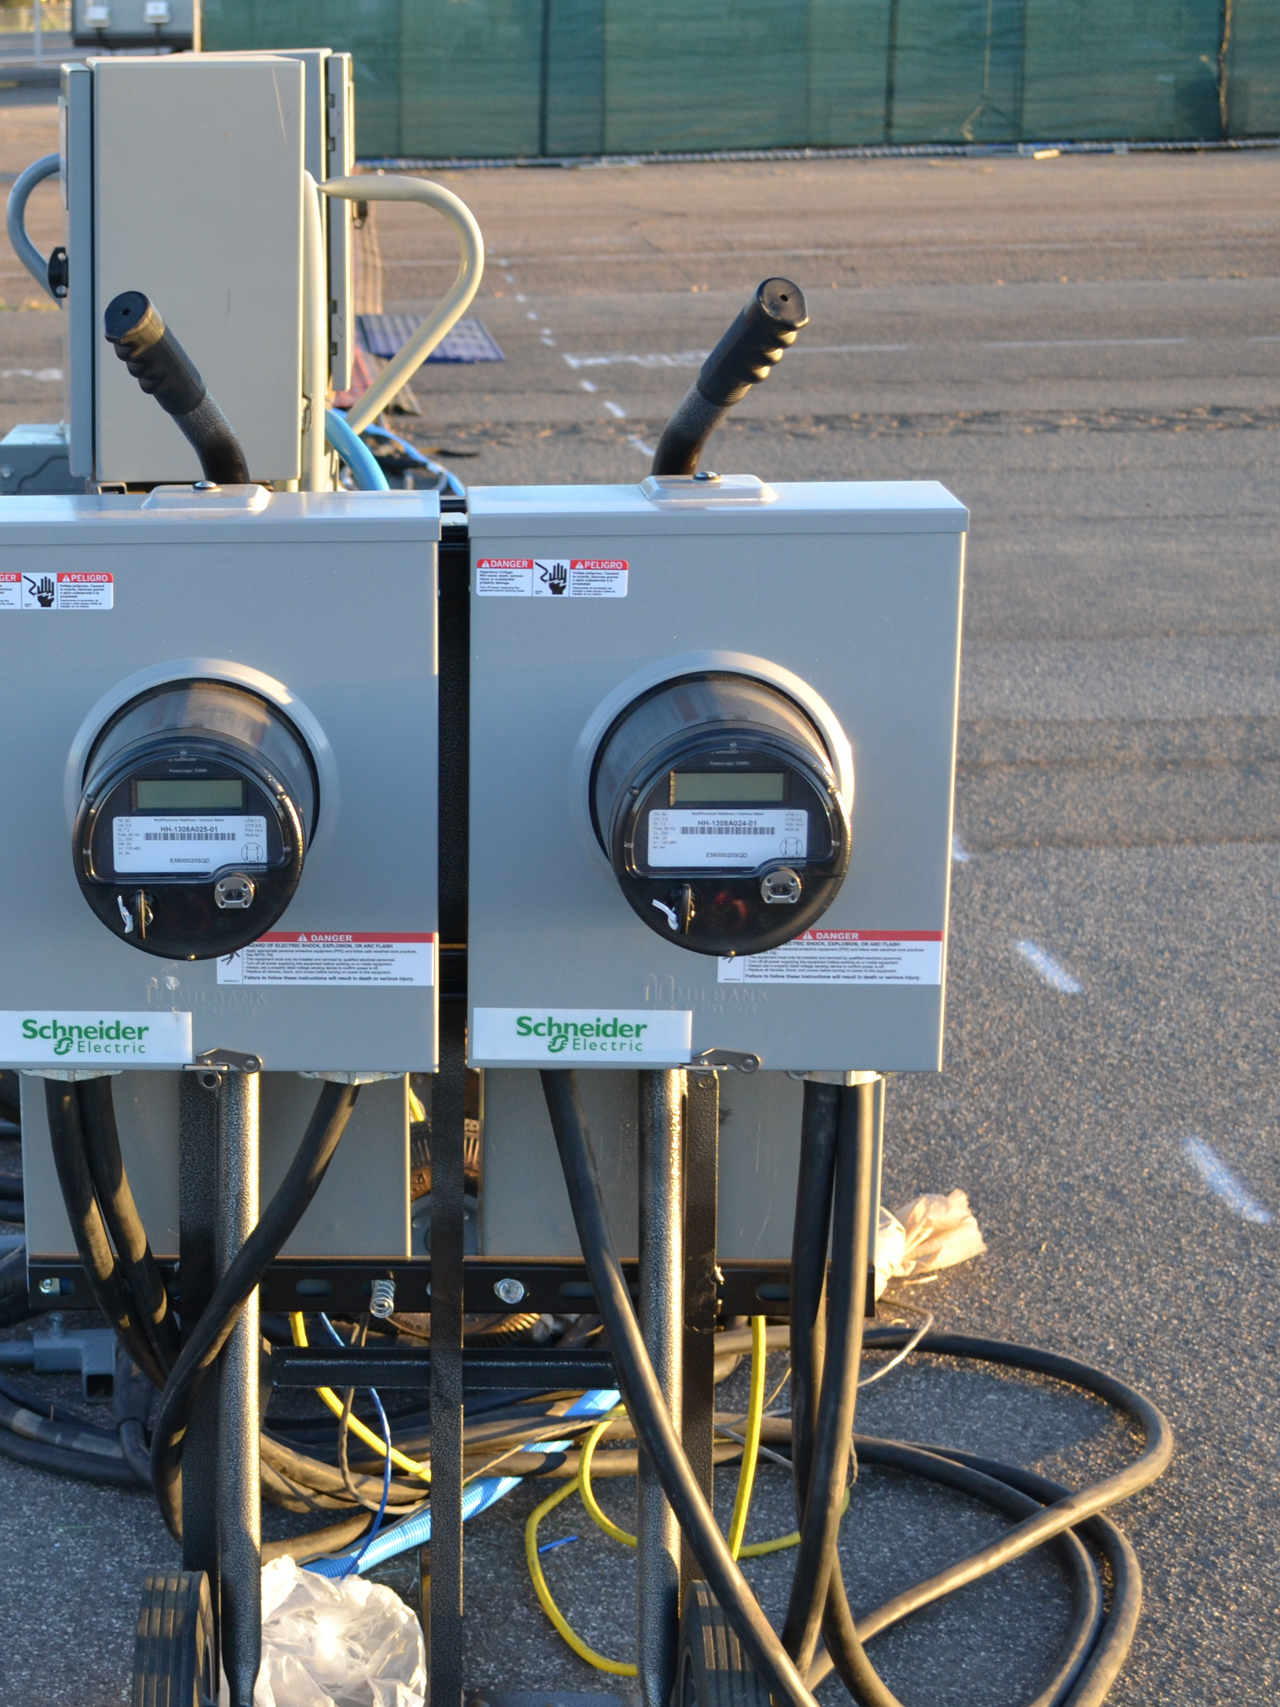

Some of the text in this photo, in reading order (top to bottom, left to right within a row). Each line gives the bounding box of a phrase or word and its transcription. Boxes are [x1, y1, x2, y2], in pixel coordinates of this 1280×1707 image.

[22, 1019, 149, 1040] Schneider
[516, 1016, 647, 1038] Schneider
[78, 1041, 146, 1053] Electric
[573, 1039, 643, 1051] Electric
